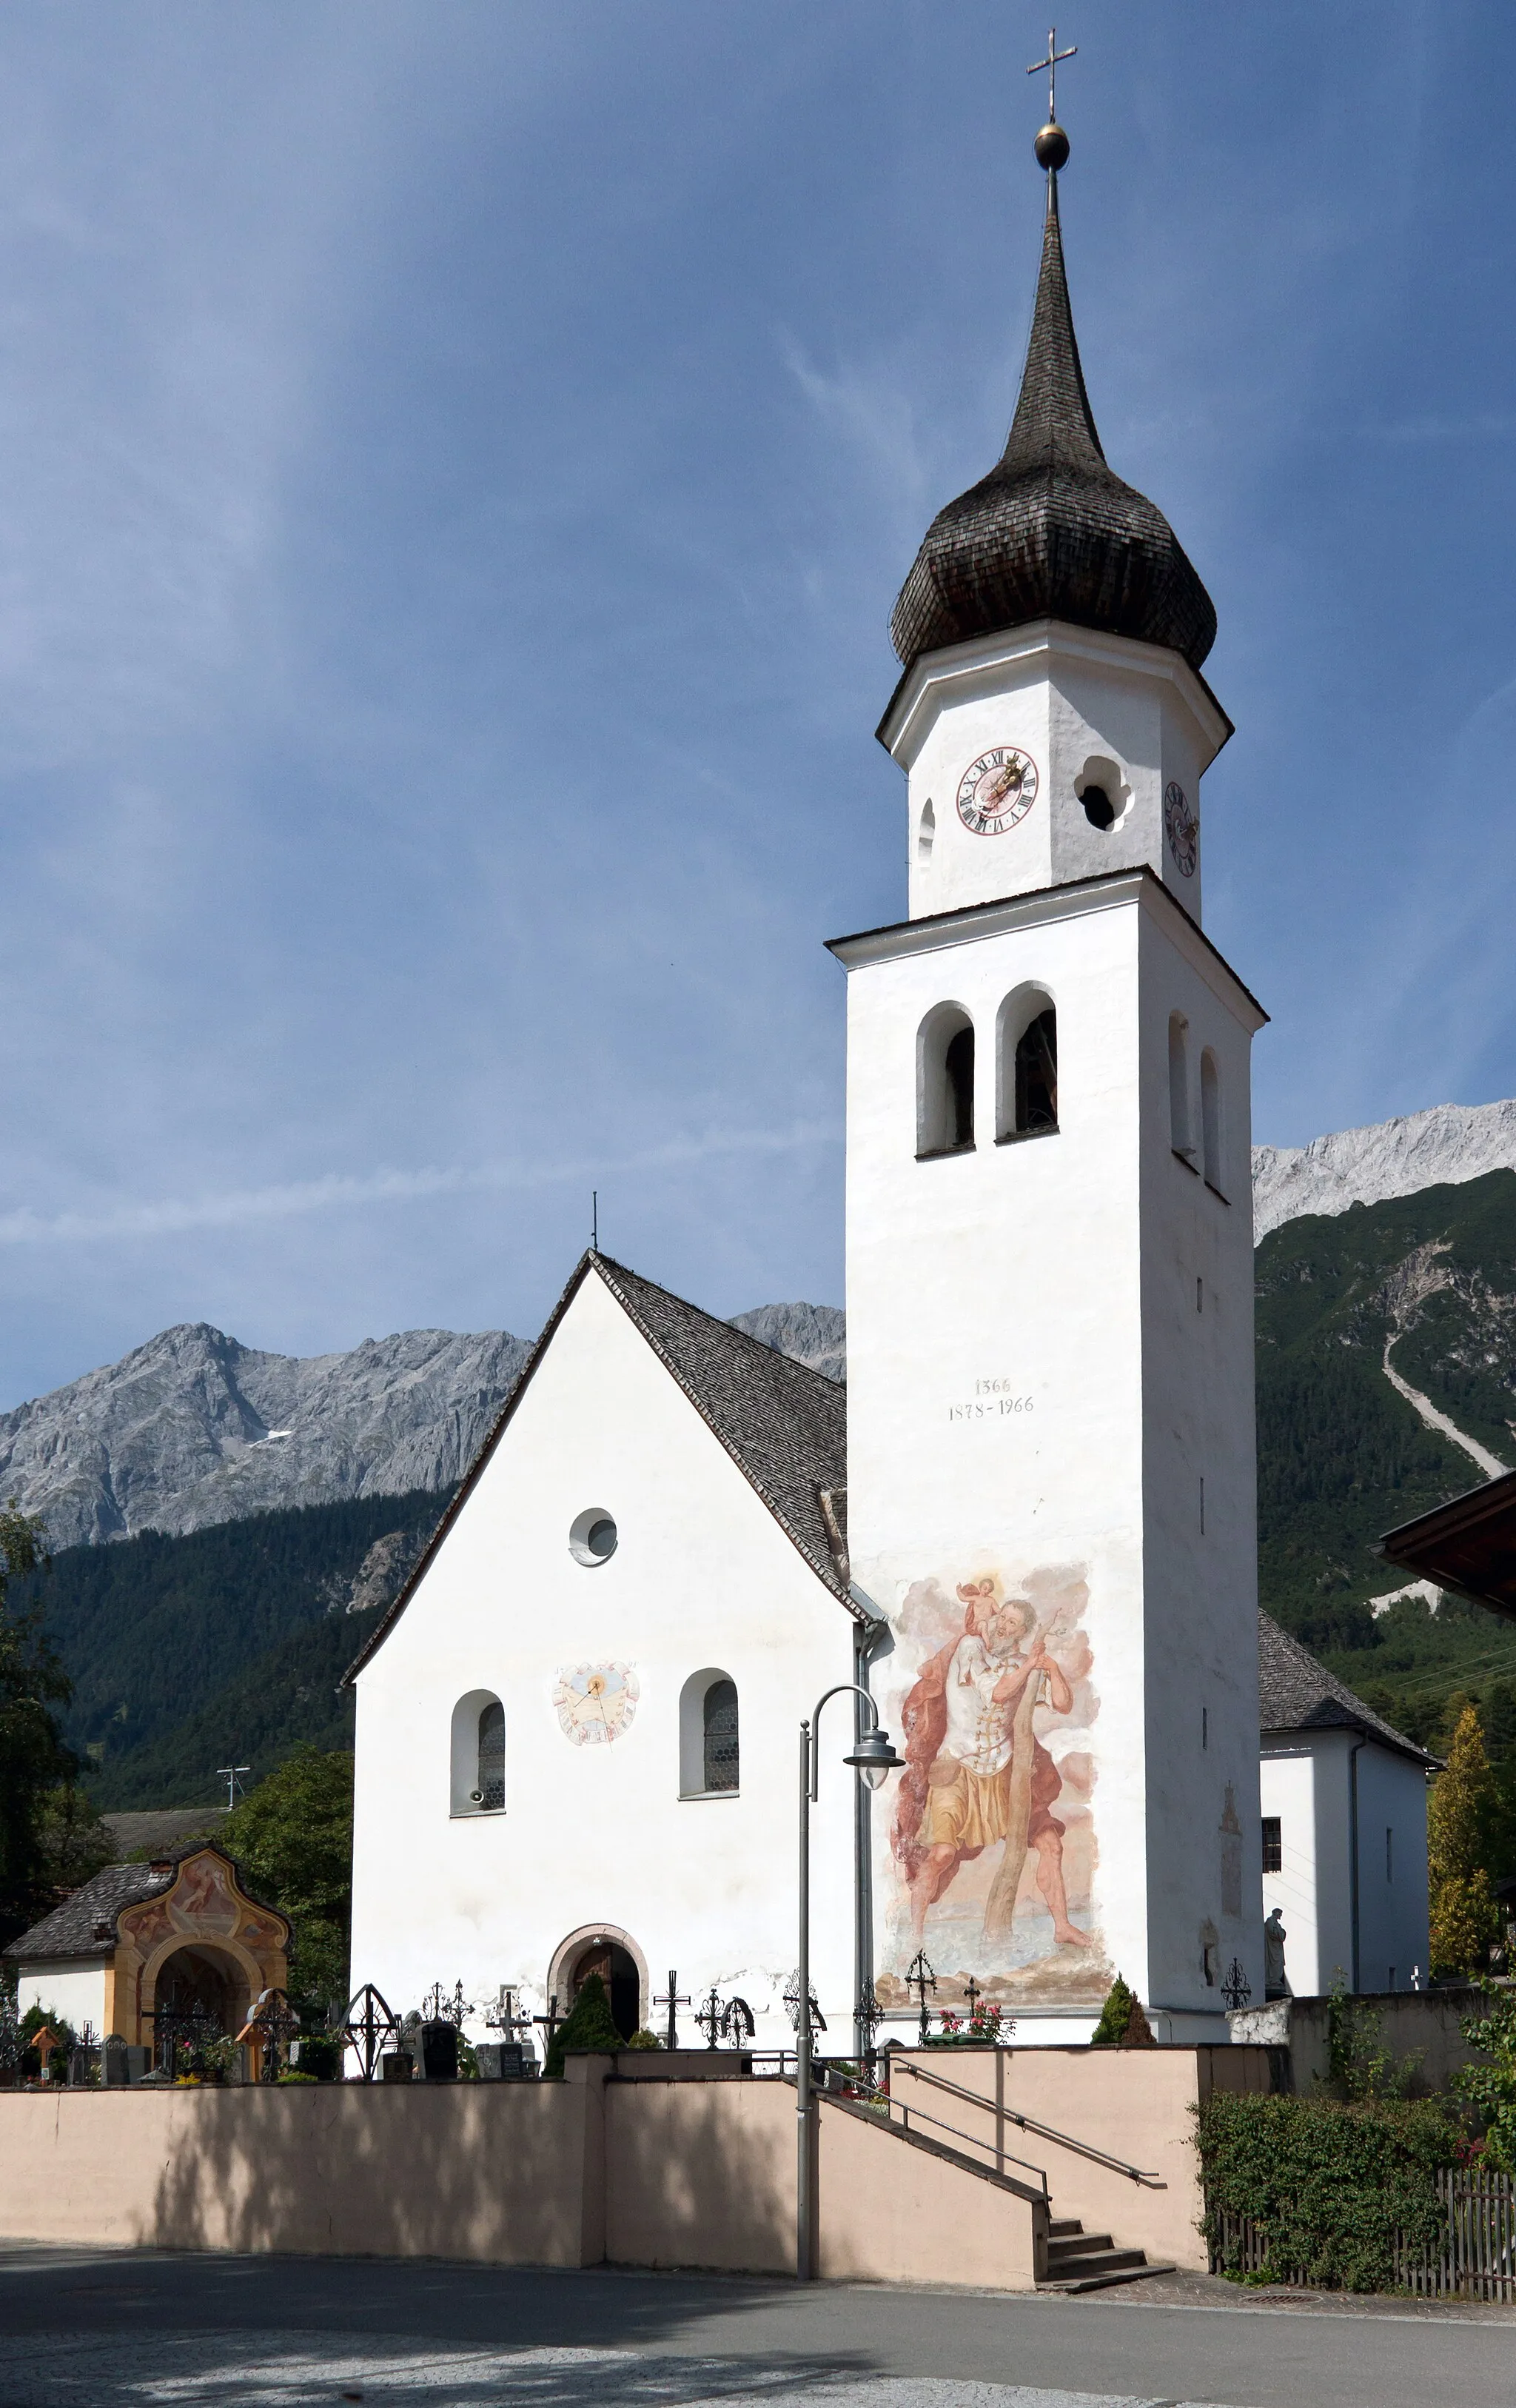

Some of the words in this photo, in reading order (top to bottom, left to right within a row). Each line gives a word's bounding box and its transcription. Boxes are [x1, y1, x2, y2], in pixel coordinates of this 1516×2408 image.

[991, 750, 1004, 766] XII
[975, 759, 988, 775] XI
[963, 777, 976, 788] X
[1023, 777, 1036, 788] III
[1010, 812, 1020, 823] V
[976, 1378, 1010, 1395] 1366
